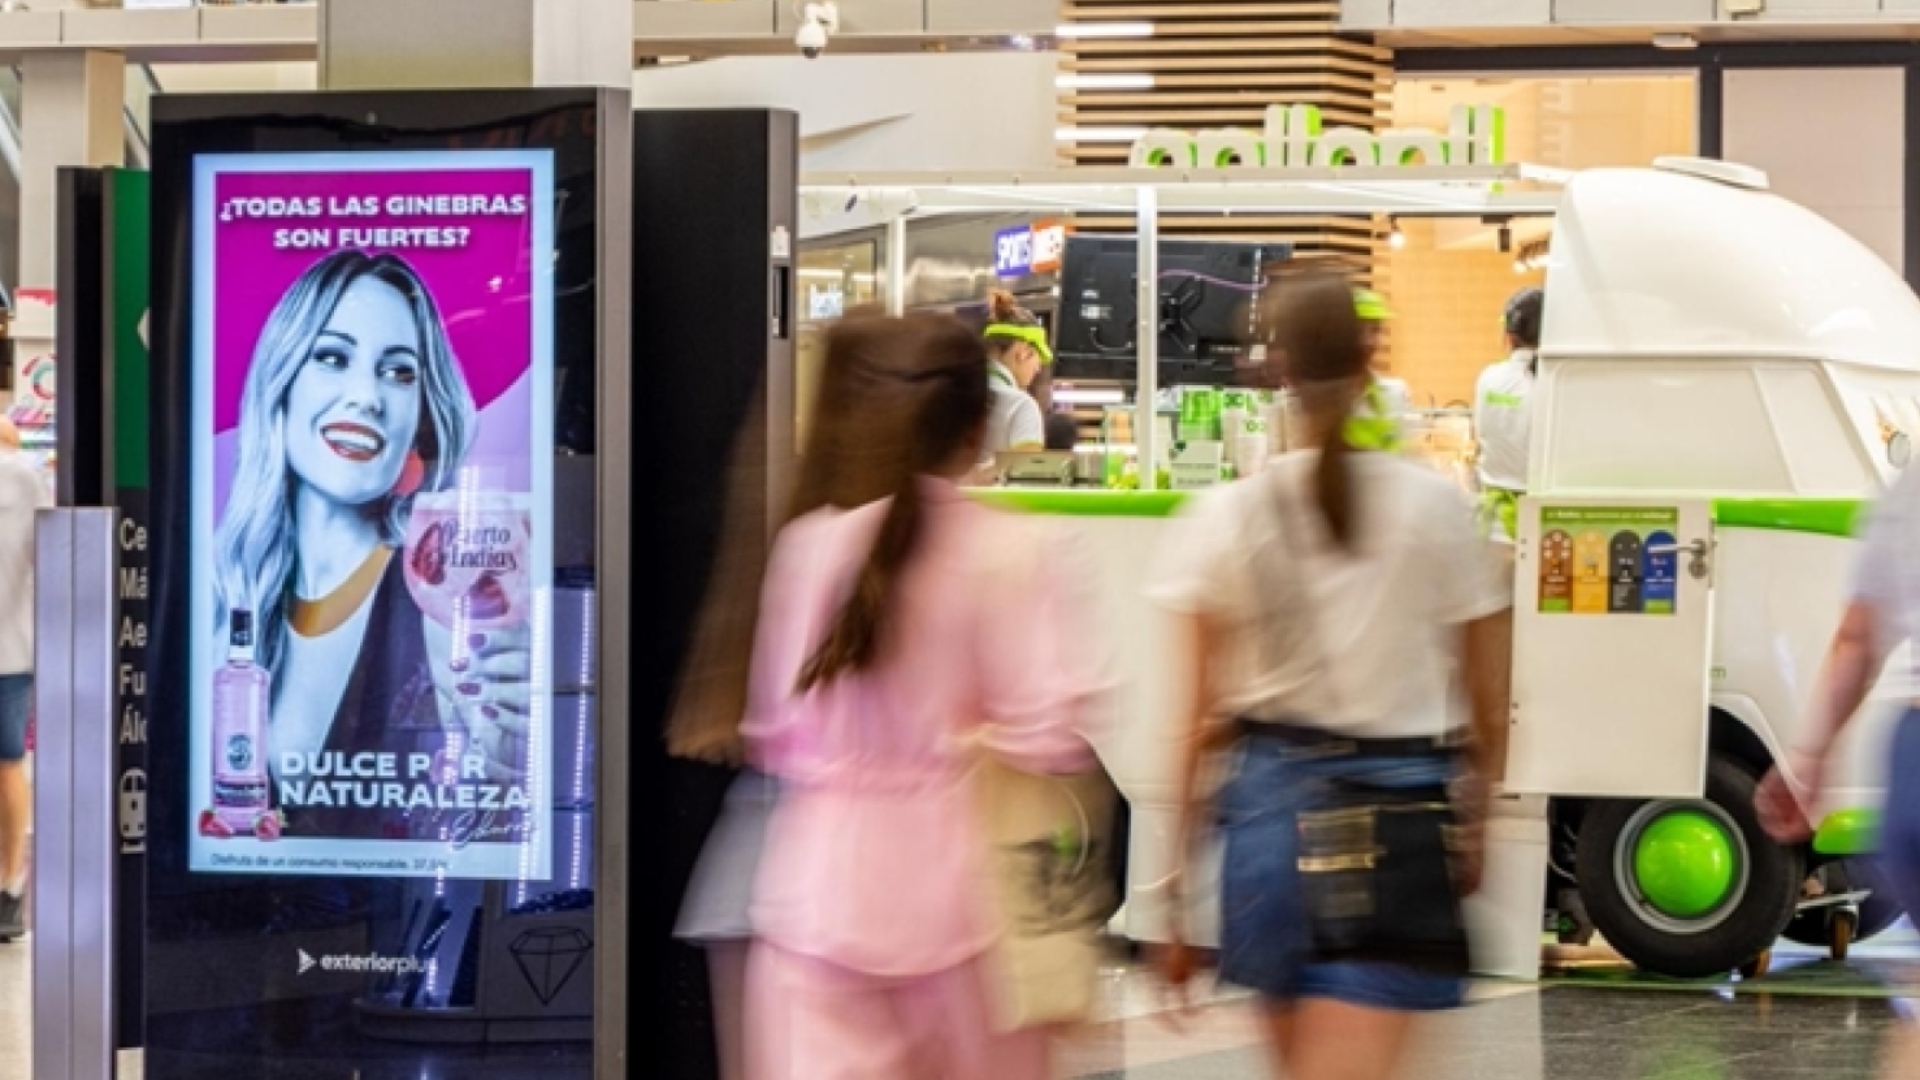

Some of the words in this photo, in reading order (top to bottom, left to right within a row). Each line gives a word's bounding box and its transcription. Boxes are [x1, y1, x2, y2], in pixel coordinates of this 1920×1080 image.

[219, 196, 322, 221] ¿TODAS
[329, 196, 379, 216] LAS
[385, 194, 527, 215] GINEBRAS
[273, 228, 330, 248] SON
[338, 227, 471, 248] FUERTES?
[280, 751, 397, 779] DULCE
[280, 780, 530, 809] NATURALEZA
